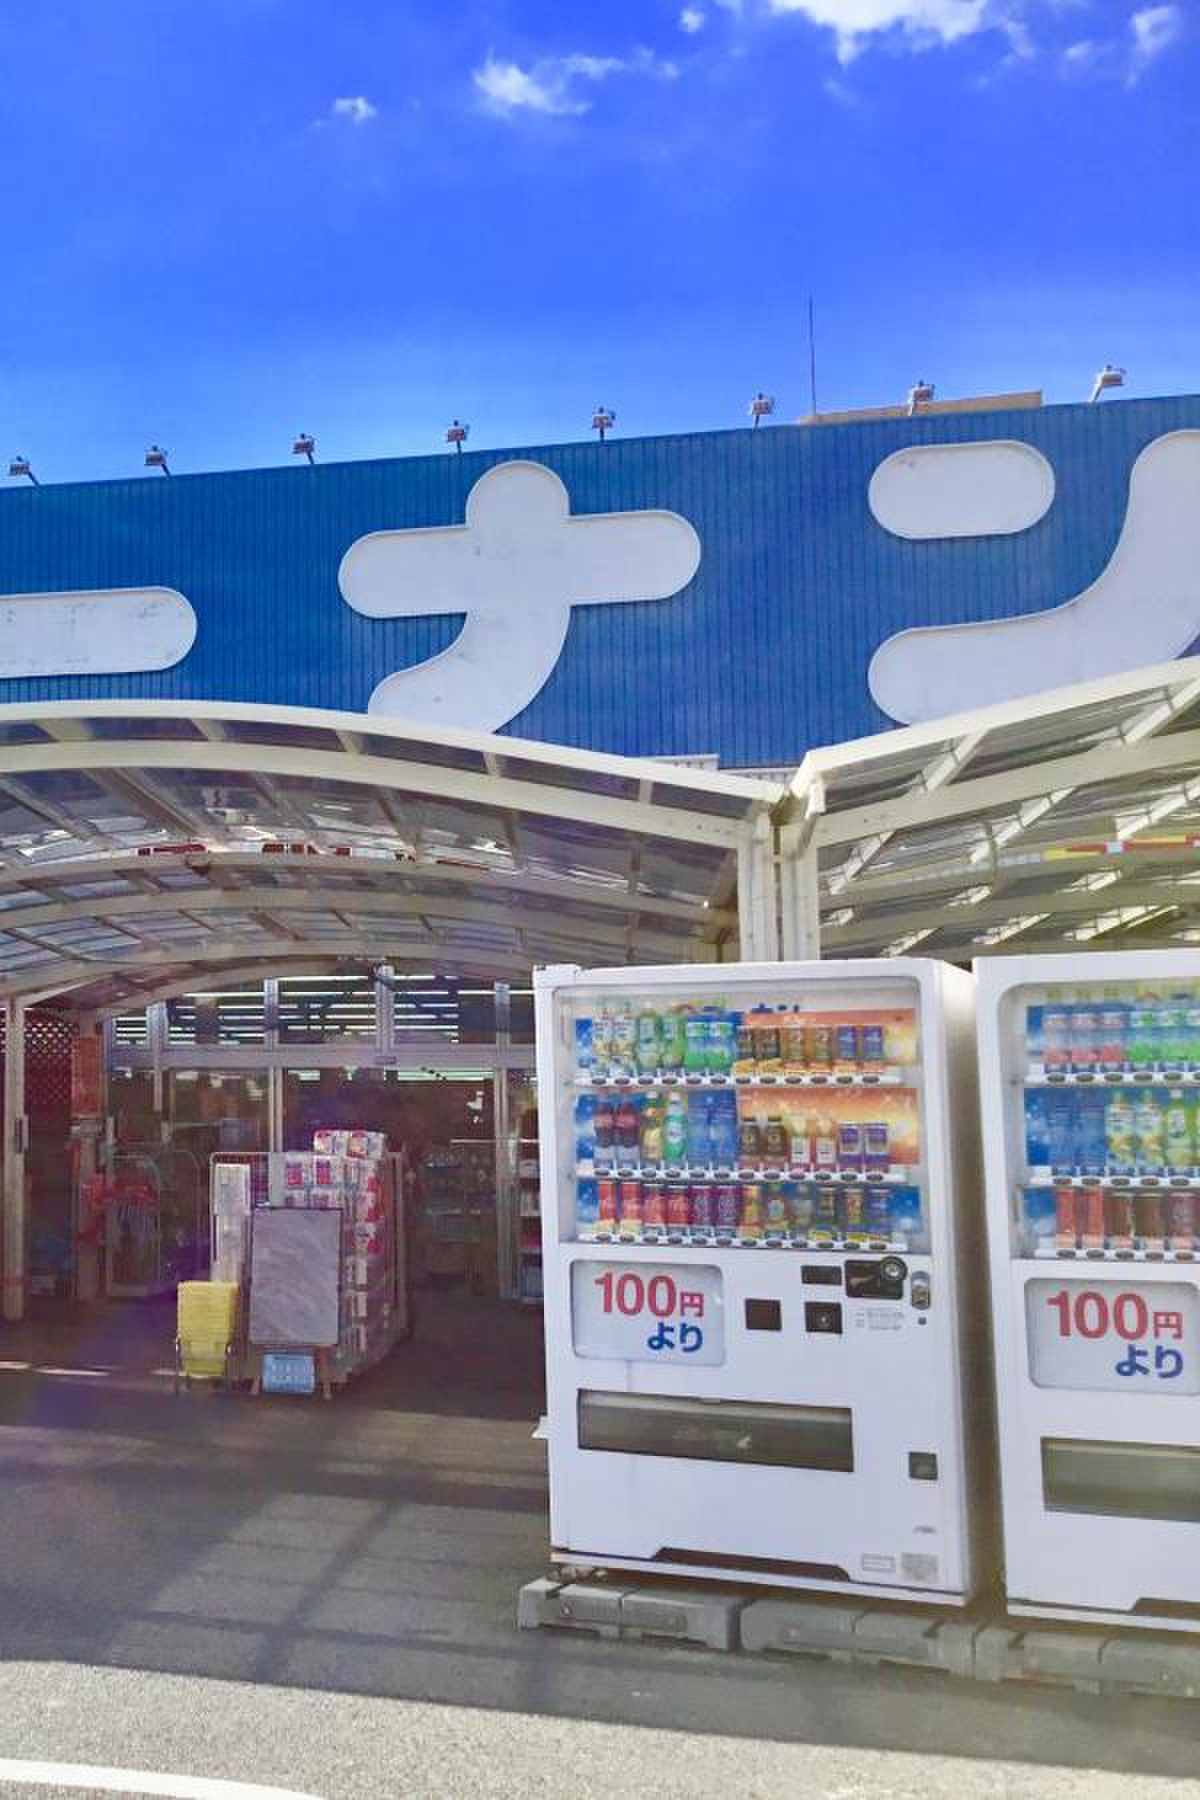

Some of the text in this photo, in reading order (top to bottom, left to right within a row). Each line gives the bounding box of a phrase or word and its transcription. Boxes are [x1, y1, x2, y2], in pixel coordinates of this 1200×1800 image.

[594, 1271, 705, 1319] 100円
[1046, 1289, 1184, 1341] 100円
[646, 1322, 704, 1354] より
[1114, 1343, 1185, 1379] より
